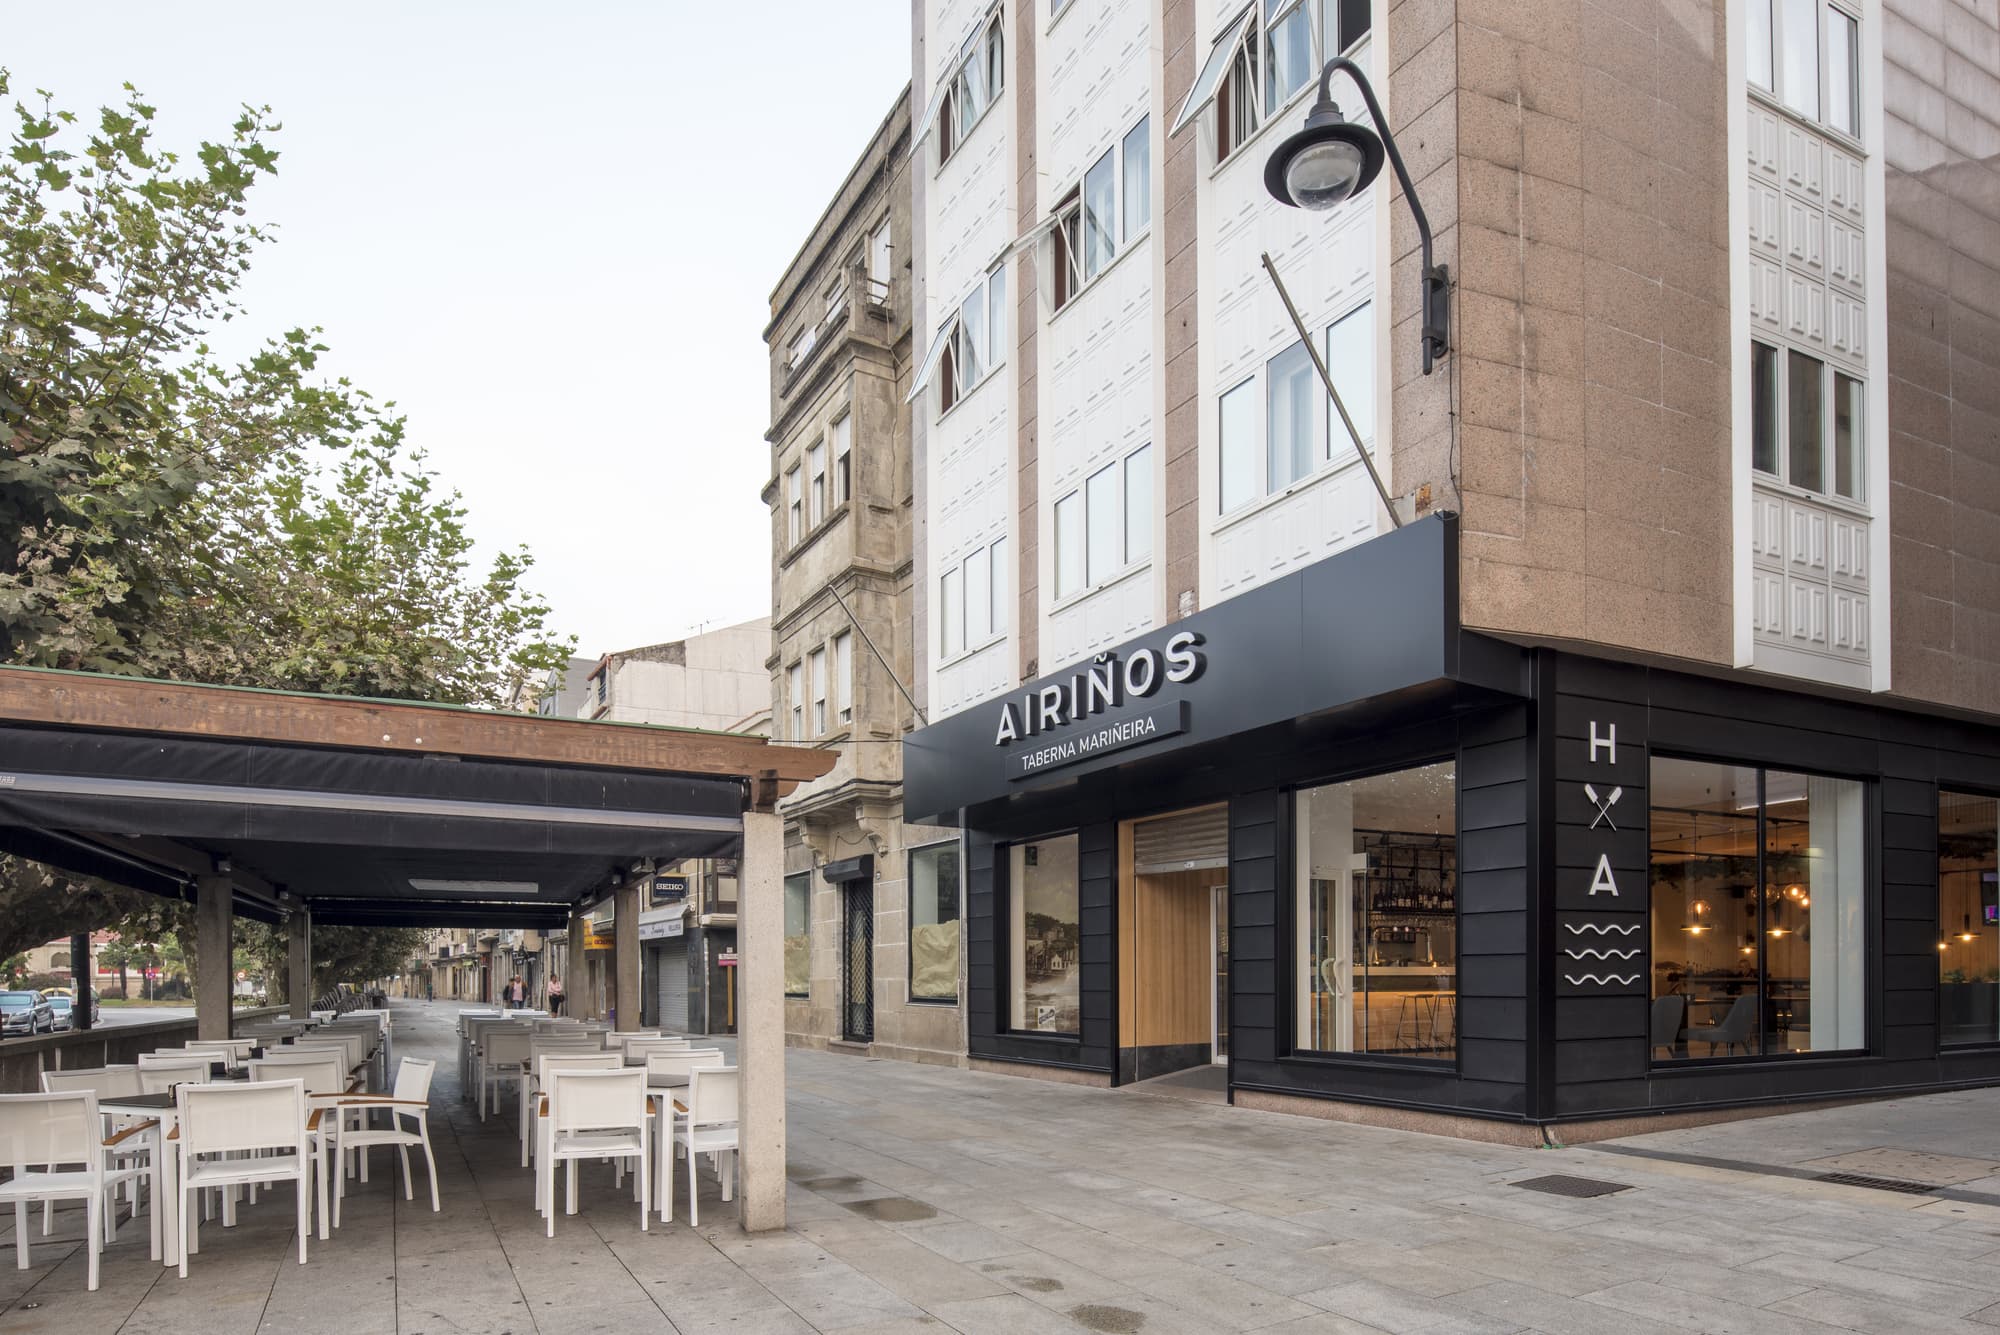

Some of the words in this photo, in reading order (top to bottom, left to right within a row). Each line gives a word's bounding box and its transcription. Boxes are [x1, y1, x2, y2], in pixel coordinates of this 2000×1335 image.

[995, 631, 1202, 746] AIRIÑOS
[1021, 741, 1076, 771] TABERNA
[1079, 716, 1156, 754] MARIÑEIRA
[1589, 721, 1616, 765] H
[655, 883, 684, 891] SEIKO
[1588, 853, 1619, 897] A
